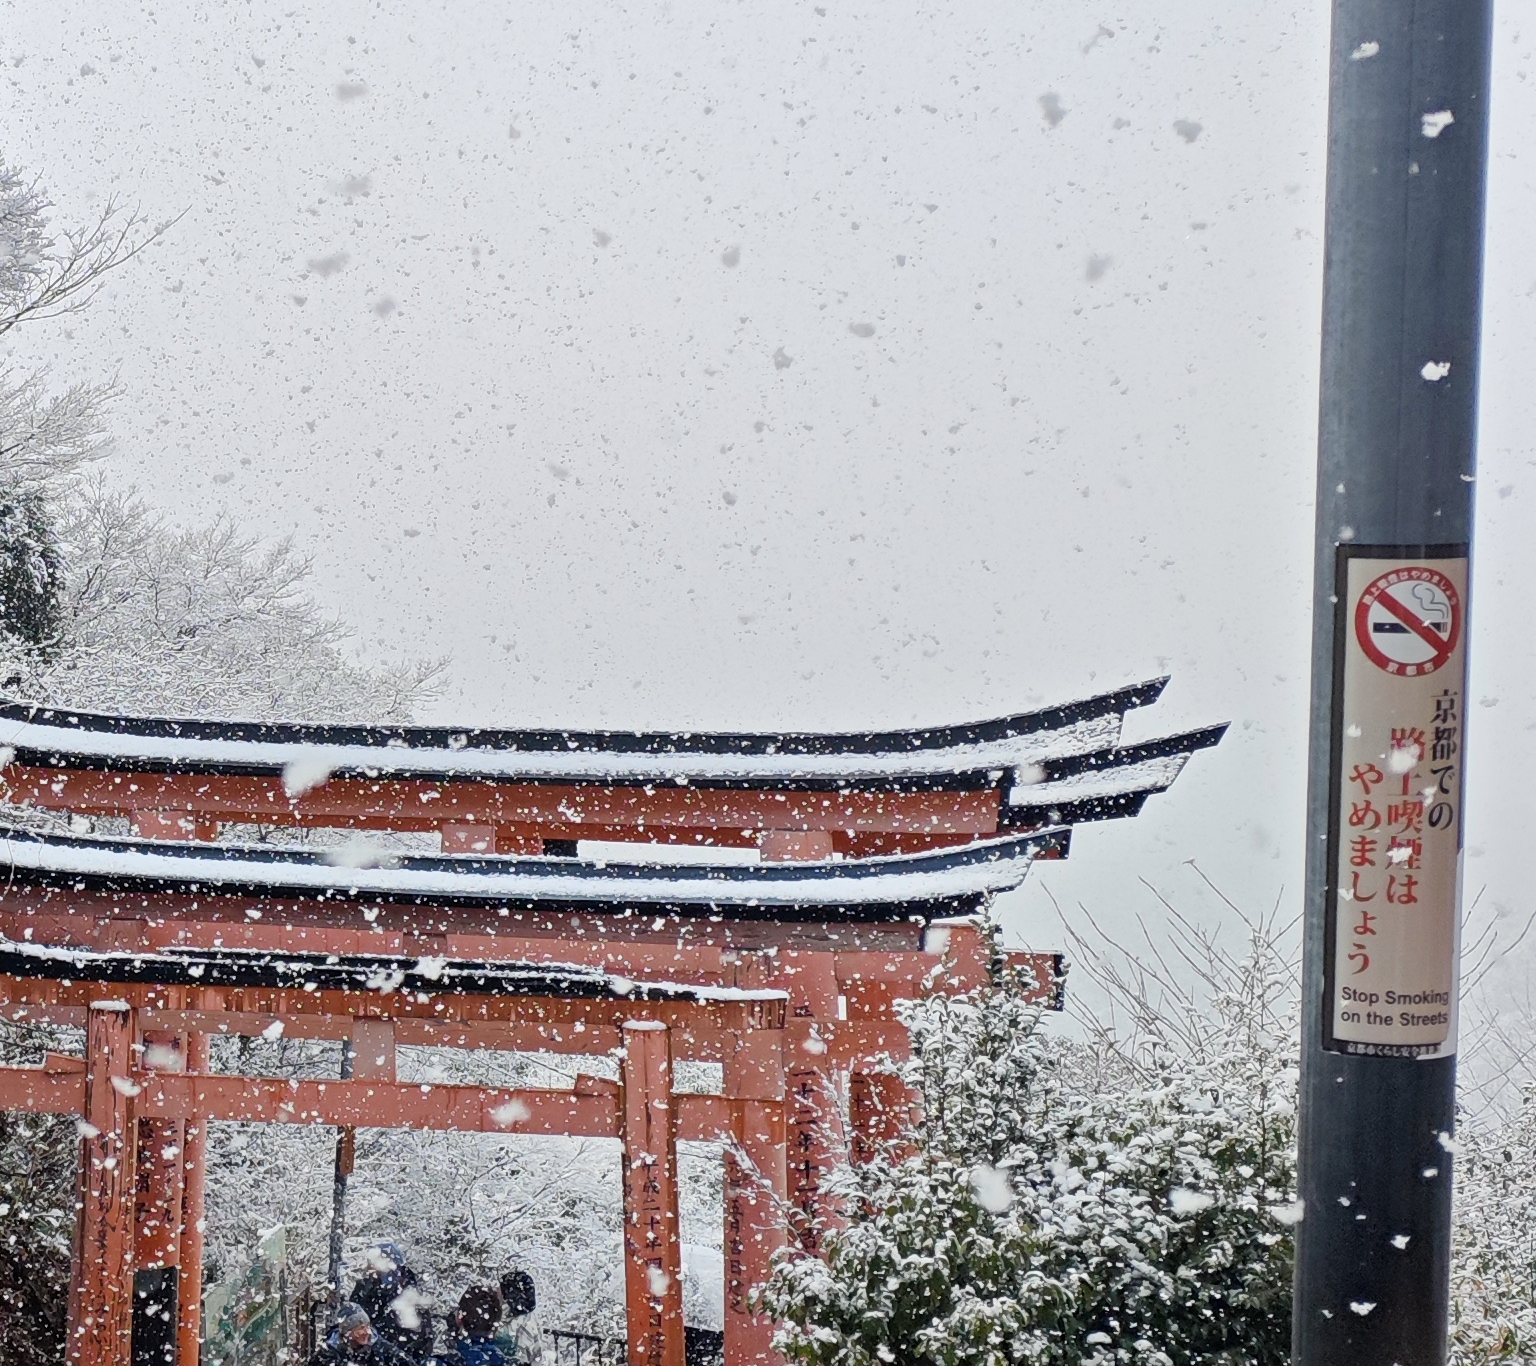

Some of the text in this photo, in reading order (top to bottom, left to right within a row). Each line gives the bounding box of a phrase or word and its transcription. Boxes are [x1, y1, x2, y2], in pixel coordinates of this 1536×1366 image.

[1428, 688, 1458, 831] 京都での
[1347, 762, 1384, 976] やめましょう
[1340, 1011, 1448, 1026] on the Streets
[1341, 986, 1449, 1007] Stop Smoking
